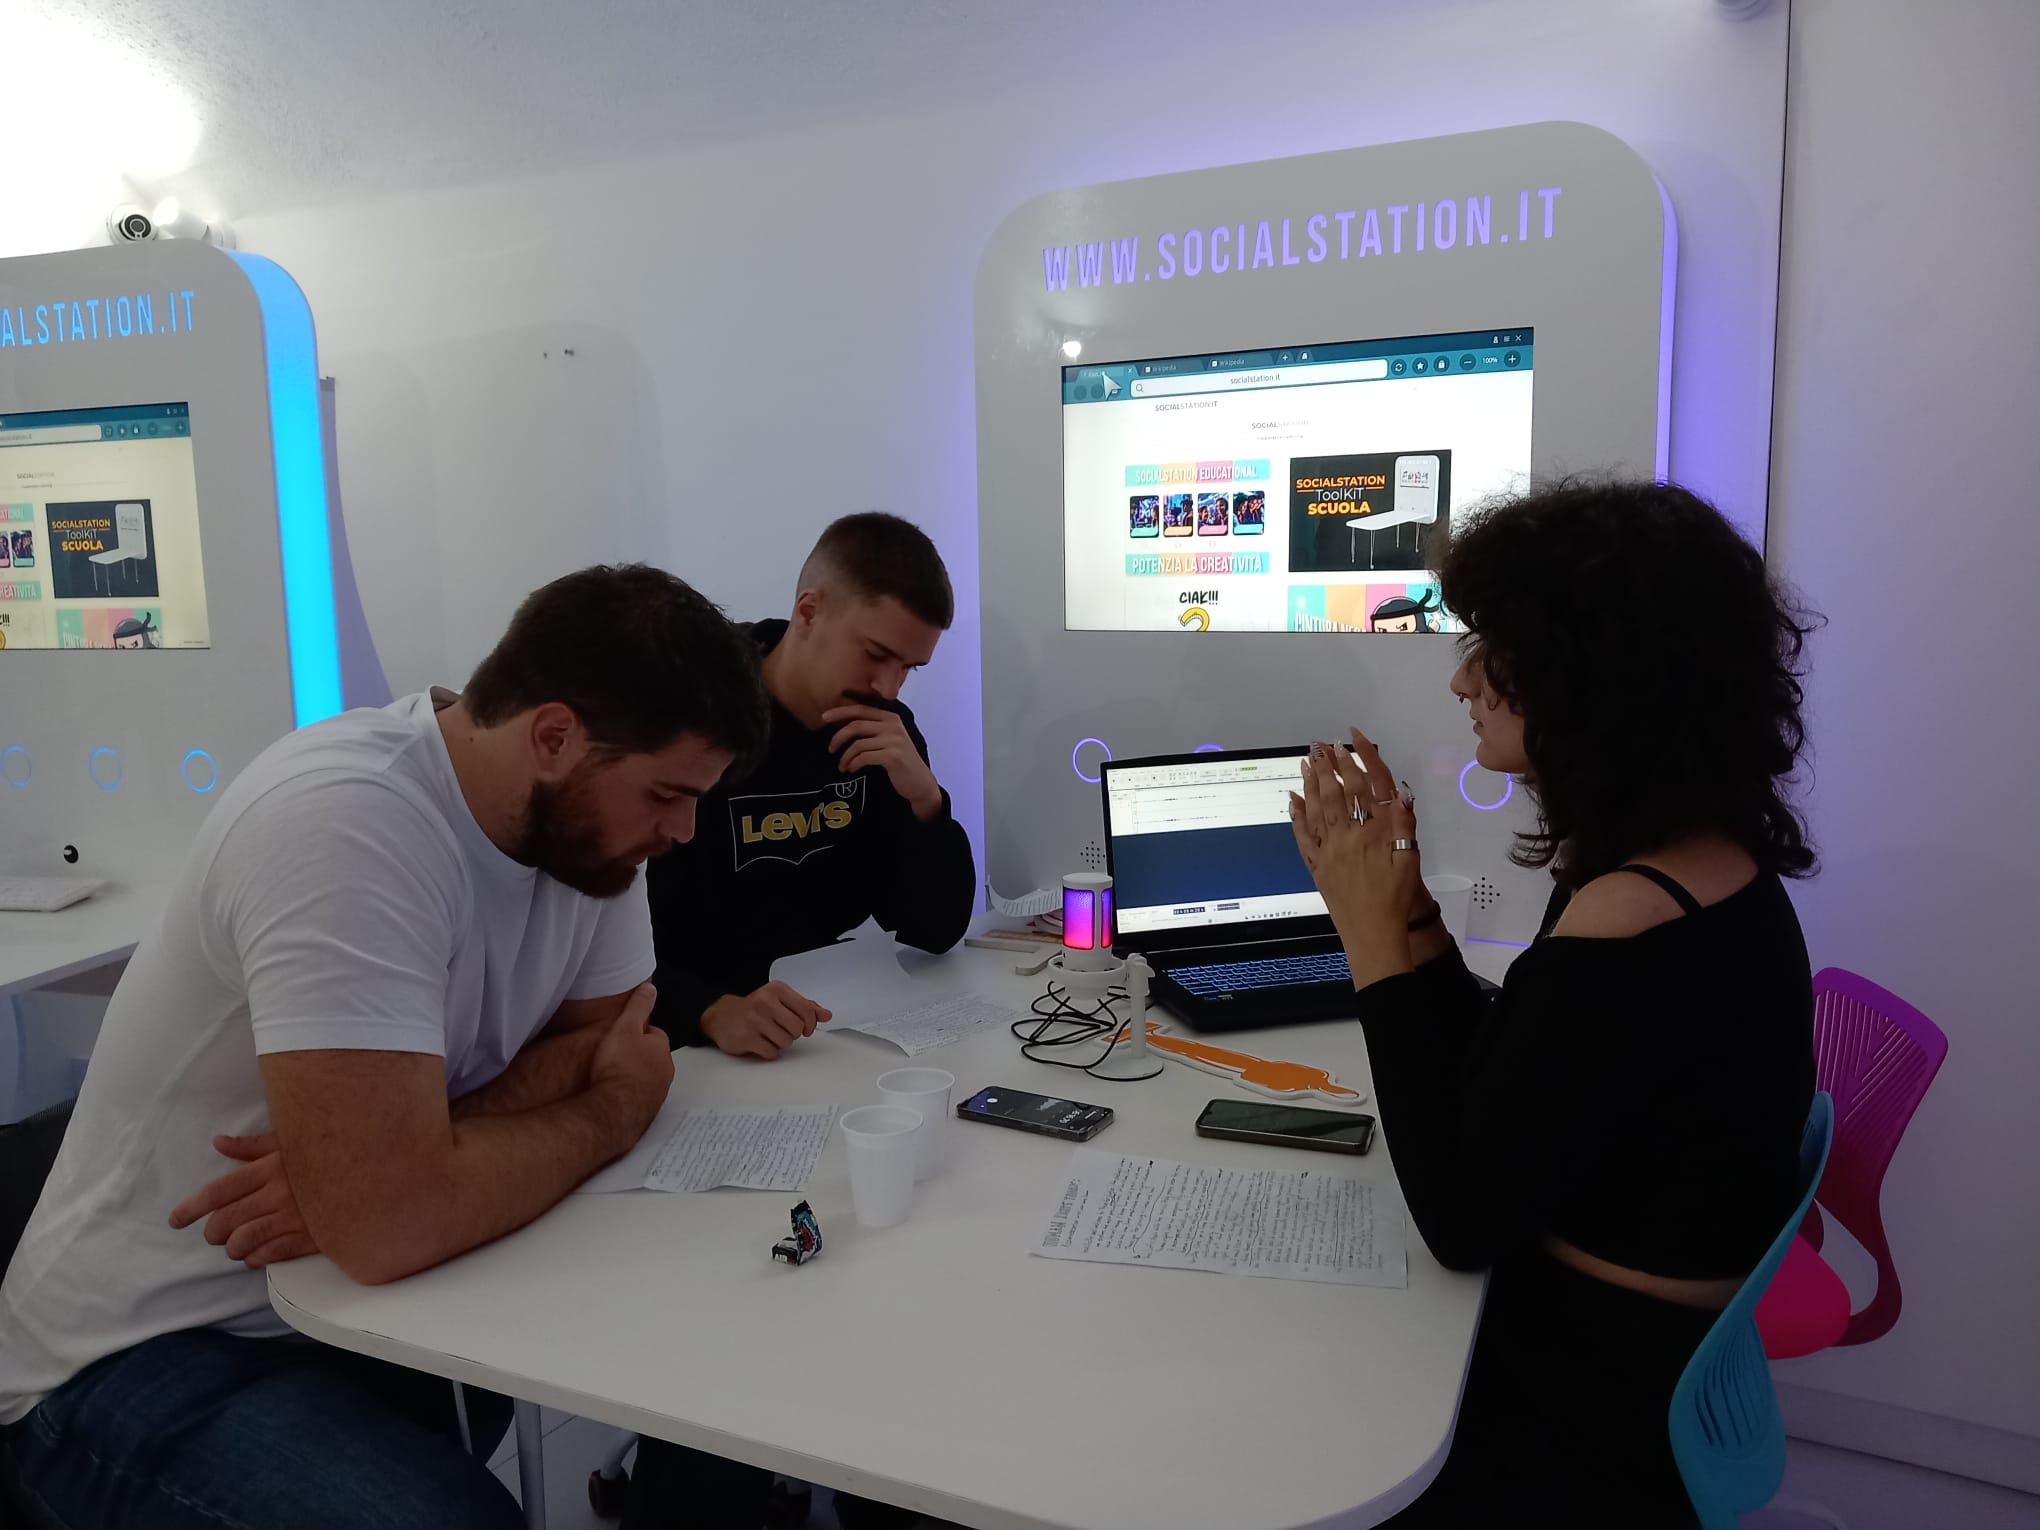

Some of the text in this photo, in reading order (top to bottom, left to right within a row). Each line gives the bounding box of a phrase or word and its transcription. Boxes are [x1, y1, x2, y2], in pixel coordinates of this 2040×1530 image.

[1042, 187, 1563, 292] WWW.SOCIALSTATION.IT
[0, 288, 194, 347] ALSTATION.IT
[1230, 373, 1280, 385] socialstation.it
[1155, 400, 1218, 412] SOCIALSTATION.IT
[1135, 464, 1257, 483] SOCIALSTATION EDUCATIONAL
[1296, 475, 1385, 489] SOCIALSTATION
[1307, 501, 1371, 515] SCUOLA
[52, 519, 111, 529] SOCIALSTATION
[62, 540, 104, 551] SCUOLA
[1132, 556, 1182, 573] POTENZIA
[1184, 556, 1198, 572] LA
[1179, 590, 1219, 606] CIAK!!!
